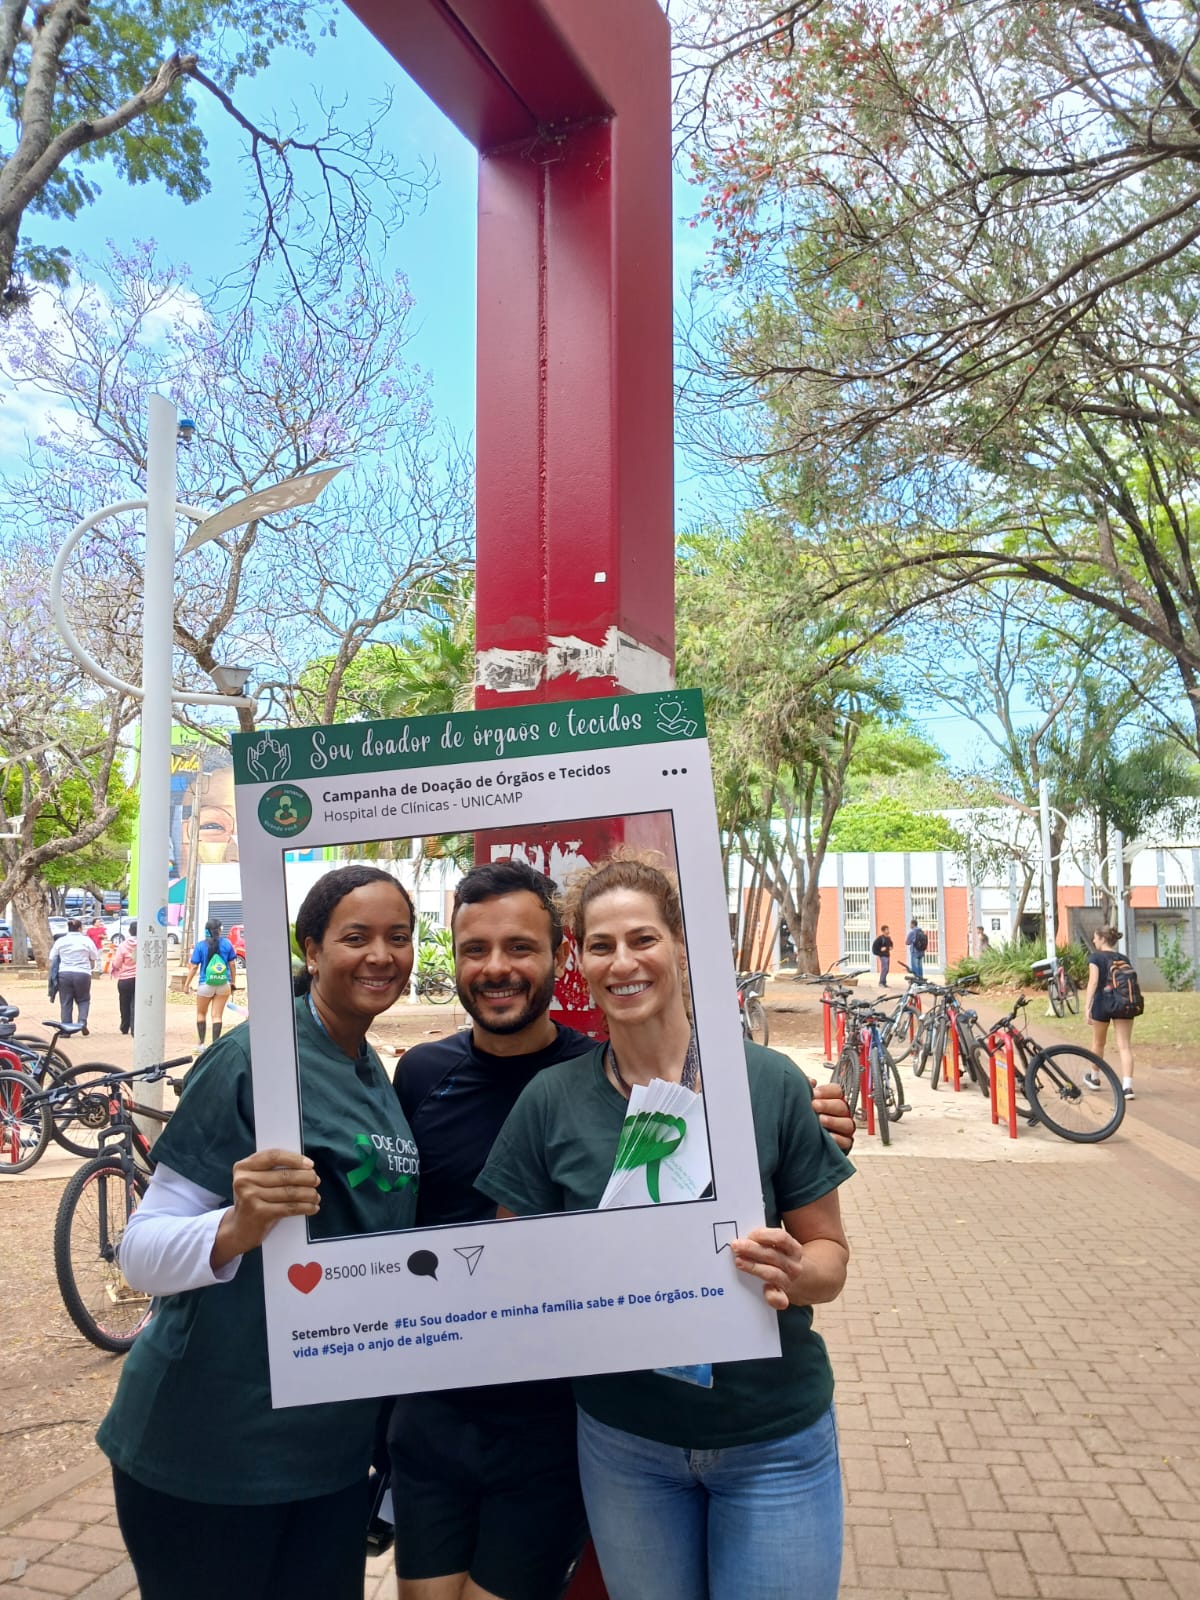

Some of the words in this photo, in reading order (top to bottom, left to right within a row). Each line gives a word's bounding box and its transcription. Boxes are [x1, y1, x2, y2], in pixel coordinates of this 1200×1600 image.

[310, 730, 354, 770] Sou
[362, 724, 431, 757] doador
[440, 720, 465, 749] de
[549, 721, 560, 738] e
[565, 703, 642, 737] tecidos
[322, 785, 397, 803] Campanha
[401, 783, 418, 795] de
[421, 778, 472, 794] Doação
[475, 775, 493, 788] de
[496, 770, 545, 787] Órgãos
[548, 771, 556, 780] e
[559, 764, 611, 779] Tecidos
[324, 805, 377, 823] Hospital
[381, 804, 397, 817] de
[401, 800, 450, 815] Clínicas
[461, 791, 523, 809] UNICAMP
[370, 1134, 396, 1152] DOE
[387, 1154, 394, 1171] E
[324, 1263, 367, 1280] 85000
[370, 1261, 401, 1276] likes
[292, 1324, 351, 1341] Setembro
[353, 1320, 389, 1334] Verde
[394, 1316, 417, 1329] #Eu
[420, 1314, 442, 1326] Sou
[445, 1310, 488, 1324] doador
[490, 1310, 498, 1319] e
[501, 1304, 539, 1318] minha
[542, 1299, 584, 1313] família
[586, 1296, 615, 1308] sabe
[628, 1293, 652, 1305] Doe
[654, 1289, 698, 1304] órgãos.
[701, 1286, 725, 1298] Doe
[292, 1344, 319, 1359] vida
[322, 1341, 354, 1356] #Seja
[357, 1341, 365, 1351] o
[368, 1336, 394, 1351] anjo
[397, 1335, 412, 1347] de
[415, 1328, 463, 1346] alguém.
